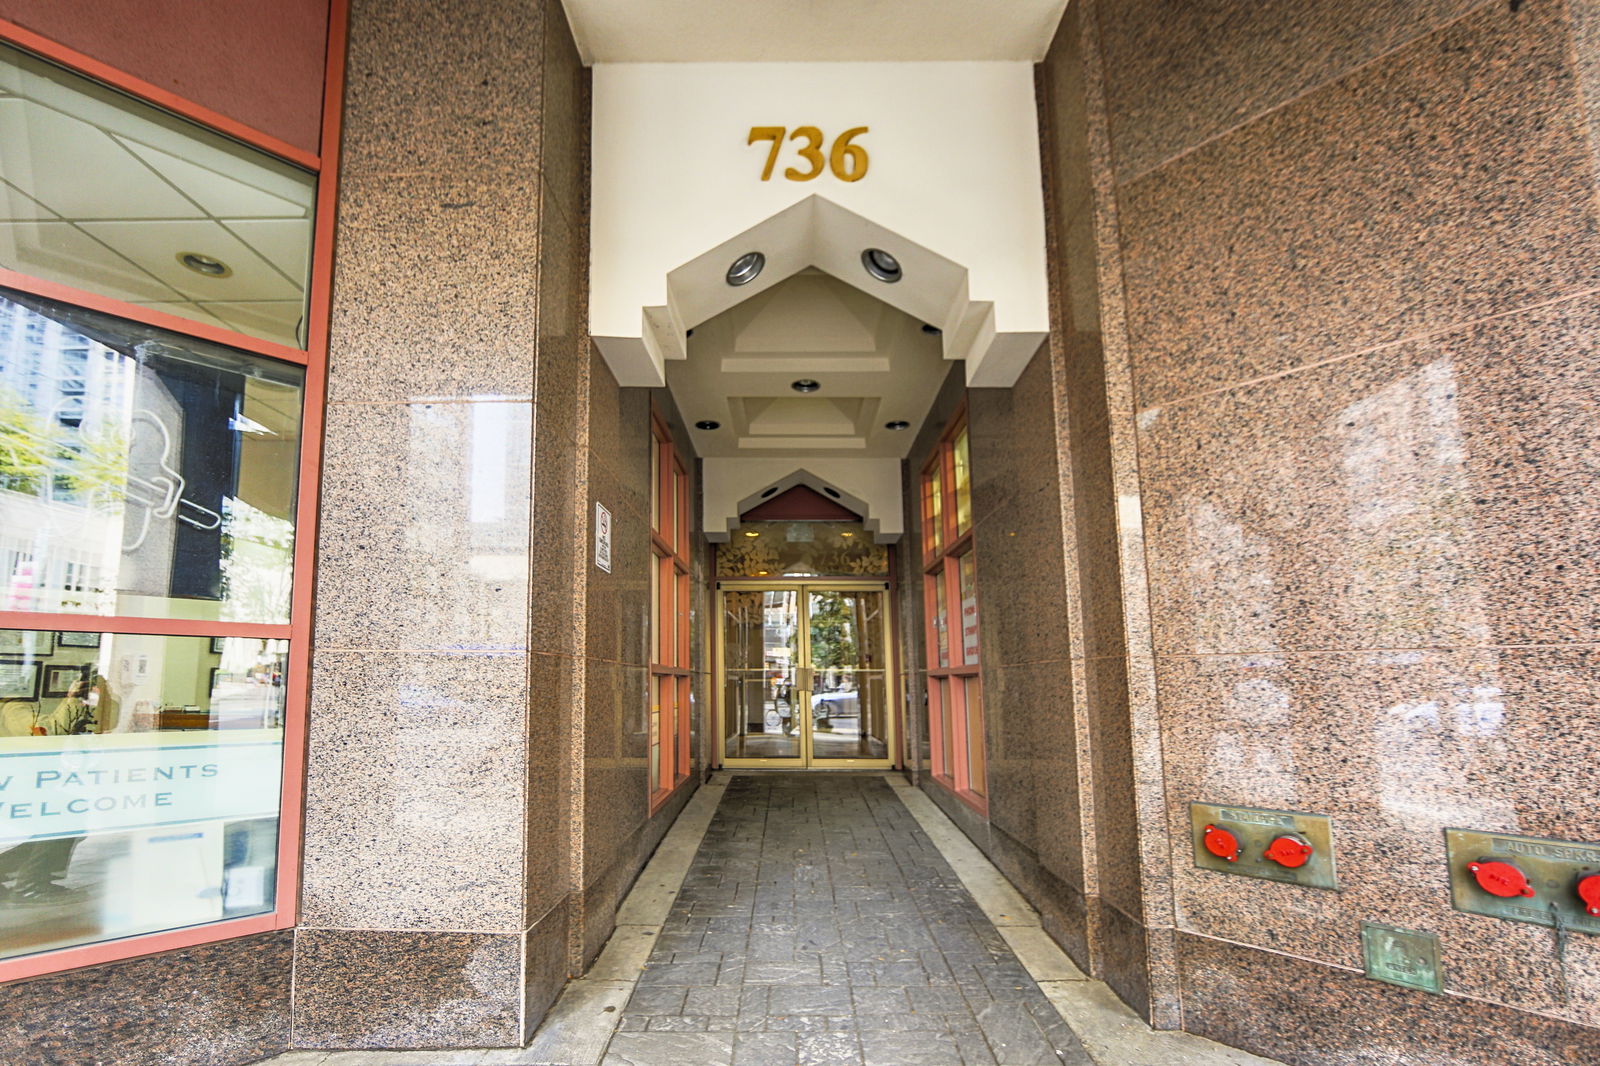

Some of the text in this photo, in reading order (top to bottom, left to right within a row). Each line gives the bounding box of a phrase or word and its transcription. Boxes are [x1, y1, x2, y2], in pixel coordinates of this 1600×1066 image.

[747, 126, 869, 183] 736
[818, 550, 850, 566] 736
[36, 764, 219, 789] PATIENTS
[0, 793, 173, 819] ELCOME
[1507, 840, 1545, 856] AUTO
